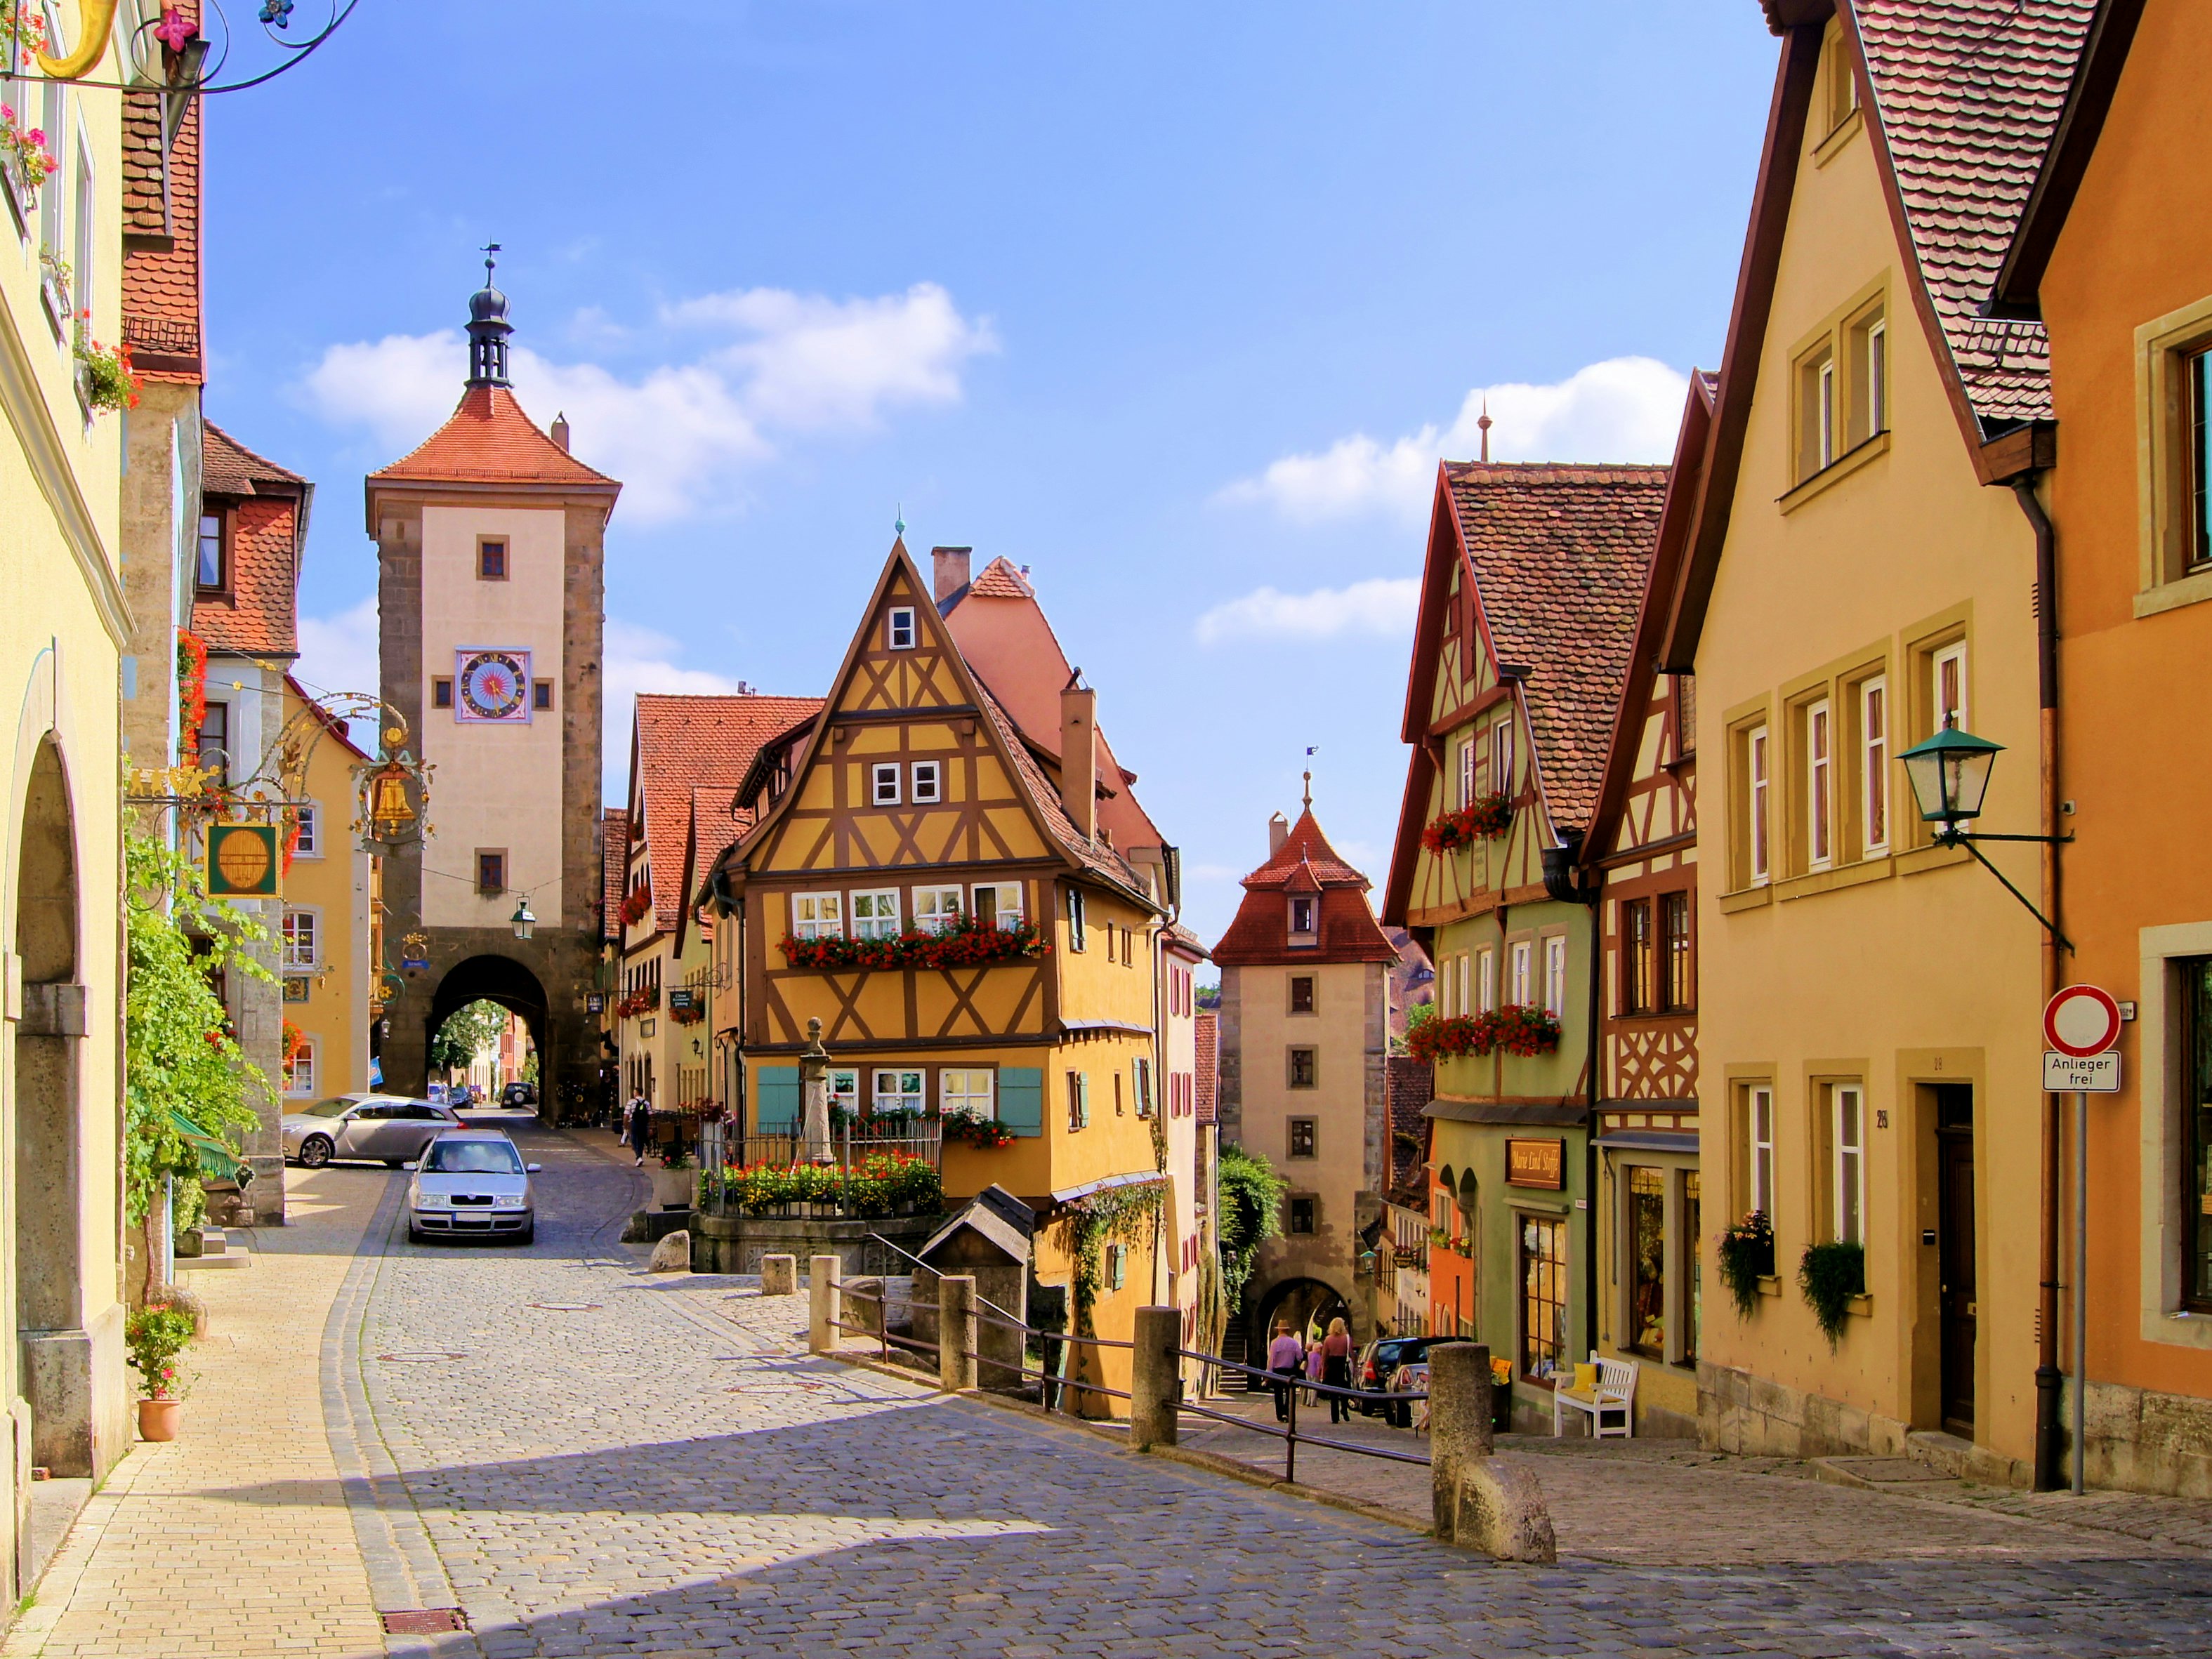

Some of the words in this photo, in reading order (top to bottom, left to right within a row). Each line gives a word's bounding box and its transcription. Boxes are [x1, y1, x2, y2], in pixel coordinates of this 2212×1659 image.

[1934, 1057, 1942, 1071] 28
[2051, 1058, 2110, 1072] Anlieger
[2069, 1073, 2093, 1084] frei
[1877, 1110, 1888, 1128] 28
[1512, 1151, 1527, 1169] Marie
[1542, 1149, 1558, 1178] Stoffe
